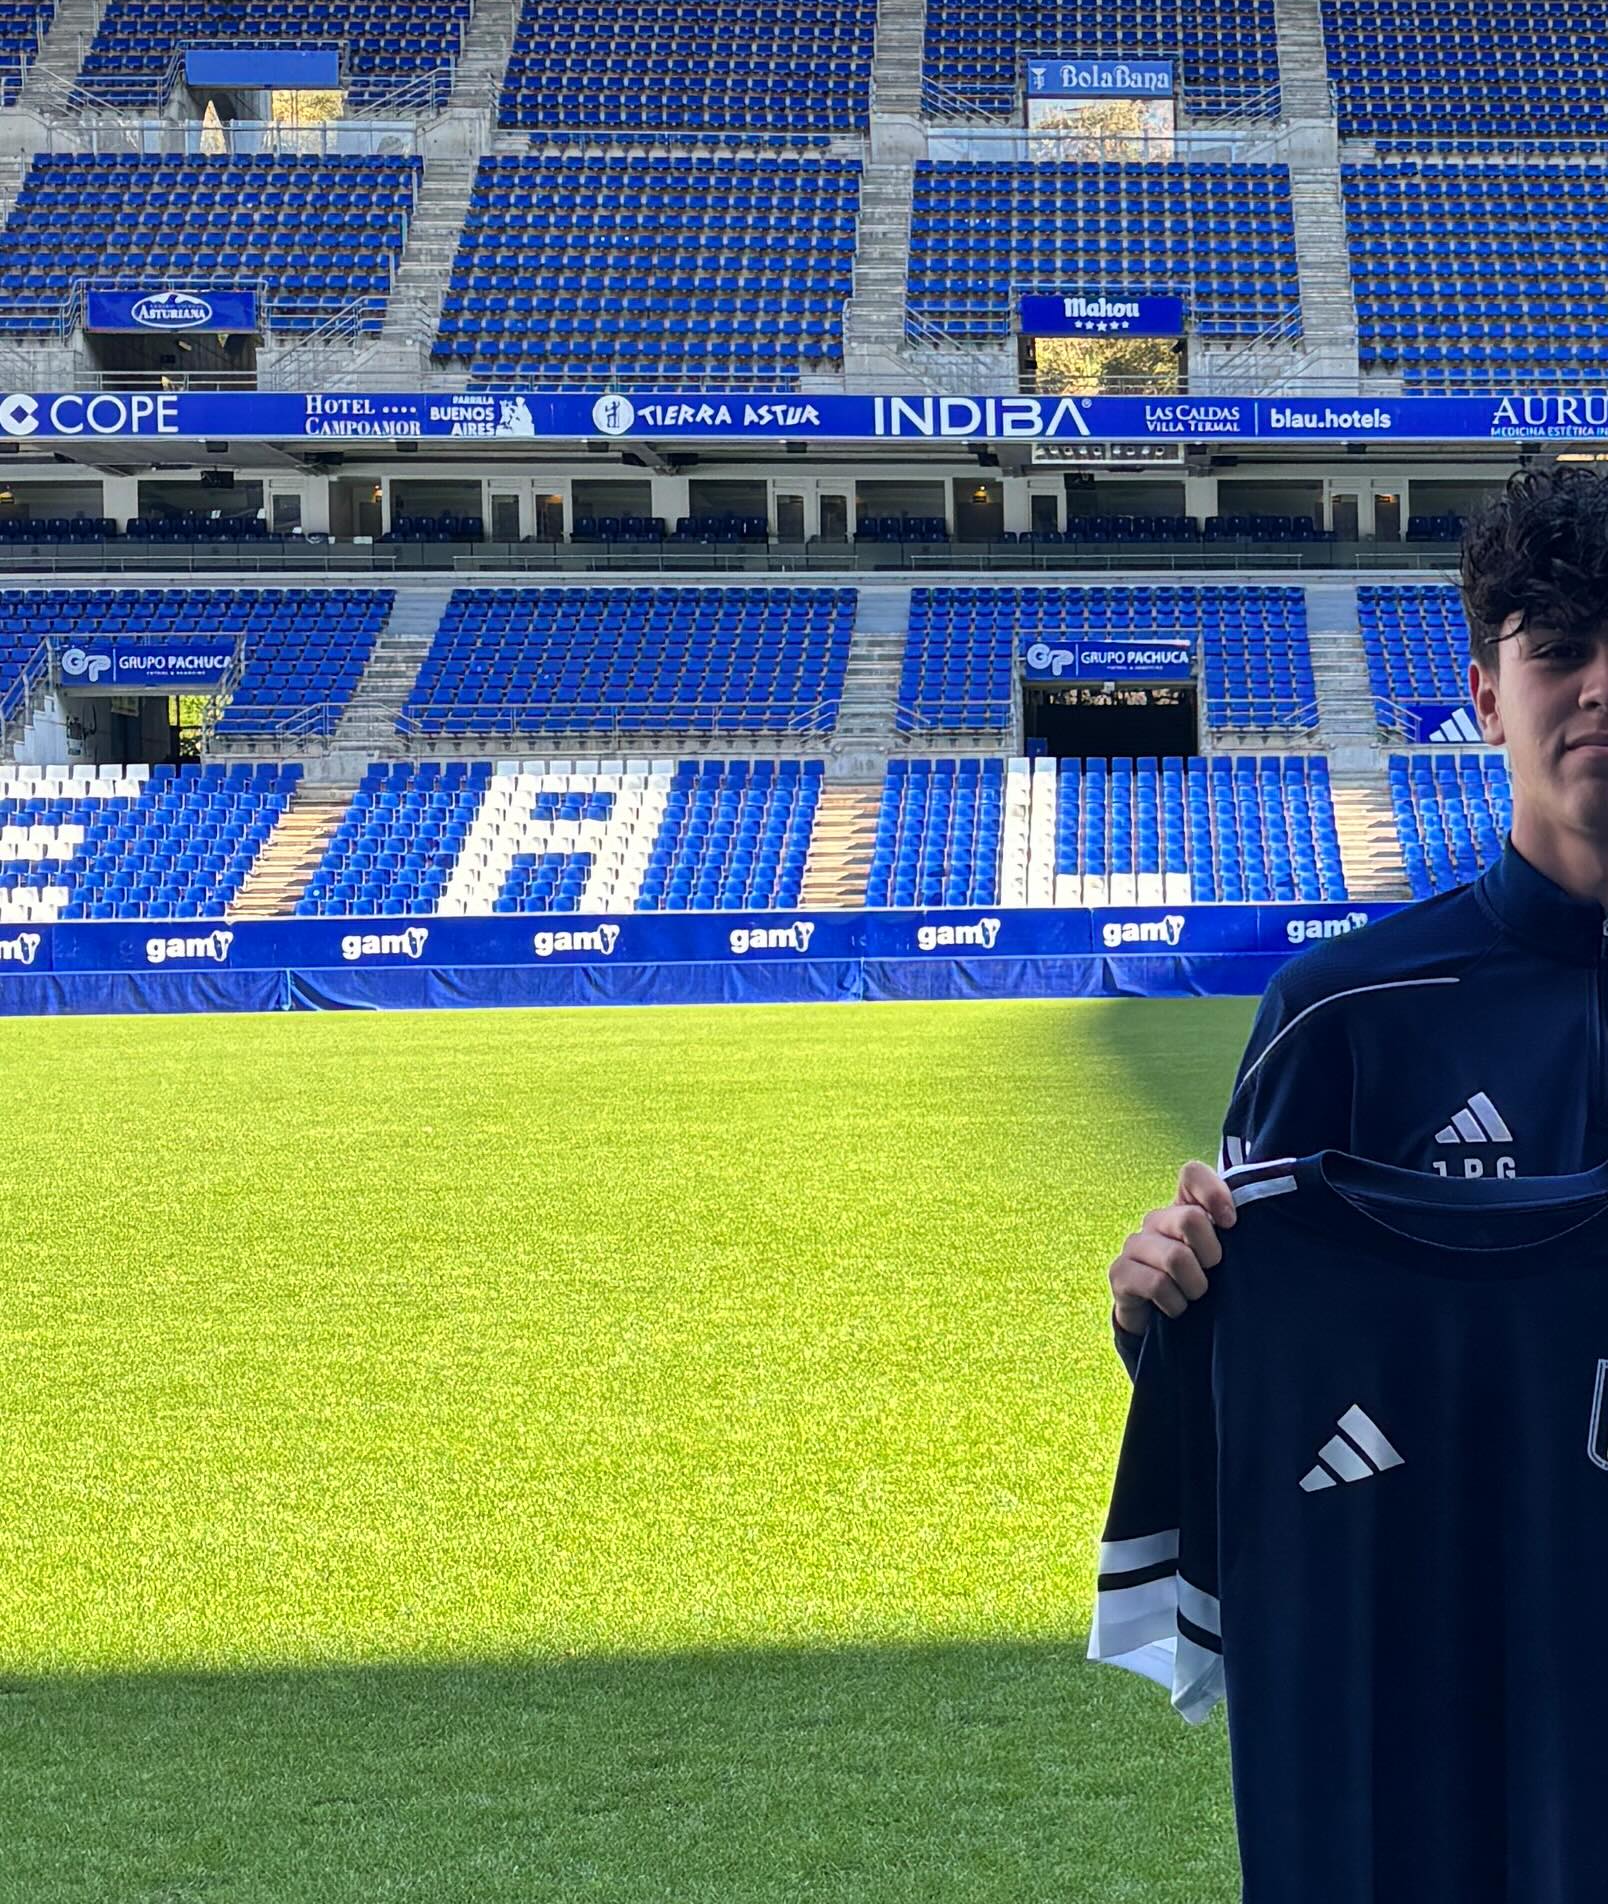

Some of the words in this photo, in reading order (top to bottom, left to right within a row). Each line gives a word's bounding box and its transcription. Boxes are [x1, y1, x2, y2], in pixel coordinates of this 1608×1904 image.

[1063, 298, 1140, 317] Mahou
[305, 395, 375, 414] HOTEL
[50, 395, 179, 434] COPE
[430, 407, 495, 421] BUENOS
[637, 404, 732, 426] TIERRA
[743, 404, 821, 426] ASTUR
[1145, 405, 1173, 420] LAS
[1176, 405, 1240, 420] CALDAS
[1270, 408, 1391, 428] blau.hotels
[305, 417, 421, 435] CAMPOAMOR
[451, 422, 496, 436] AIRES
[1147, 420, 1184, 432] VILLA
[1190, 420, 1240, 432] TERMAL
[1491, 426, 1546, 436] MEDICINA
[119, 656, 165, 669] GRUPO
[168, 656, 233, 669] PACHUCA
[1081, 651, 1125, 664] GRUPO
[1127, 651, 1189, 664] PACHUCA
